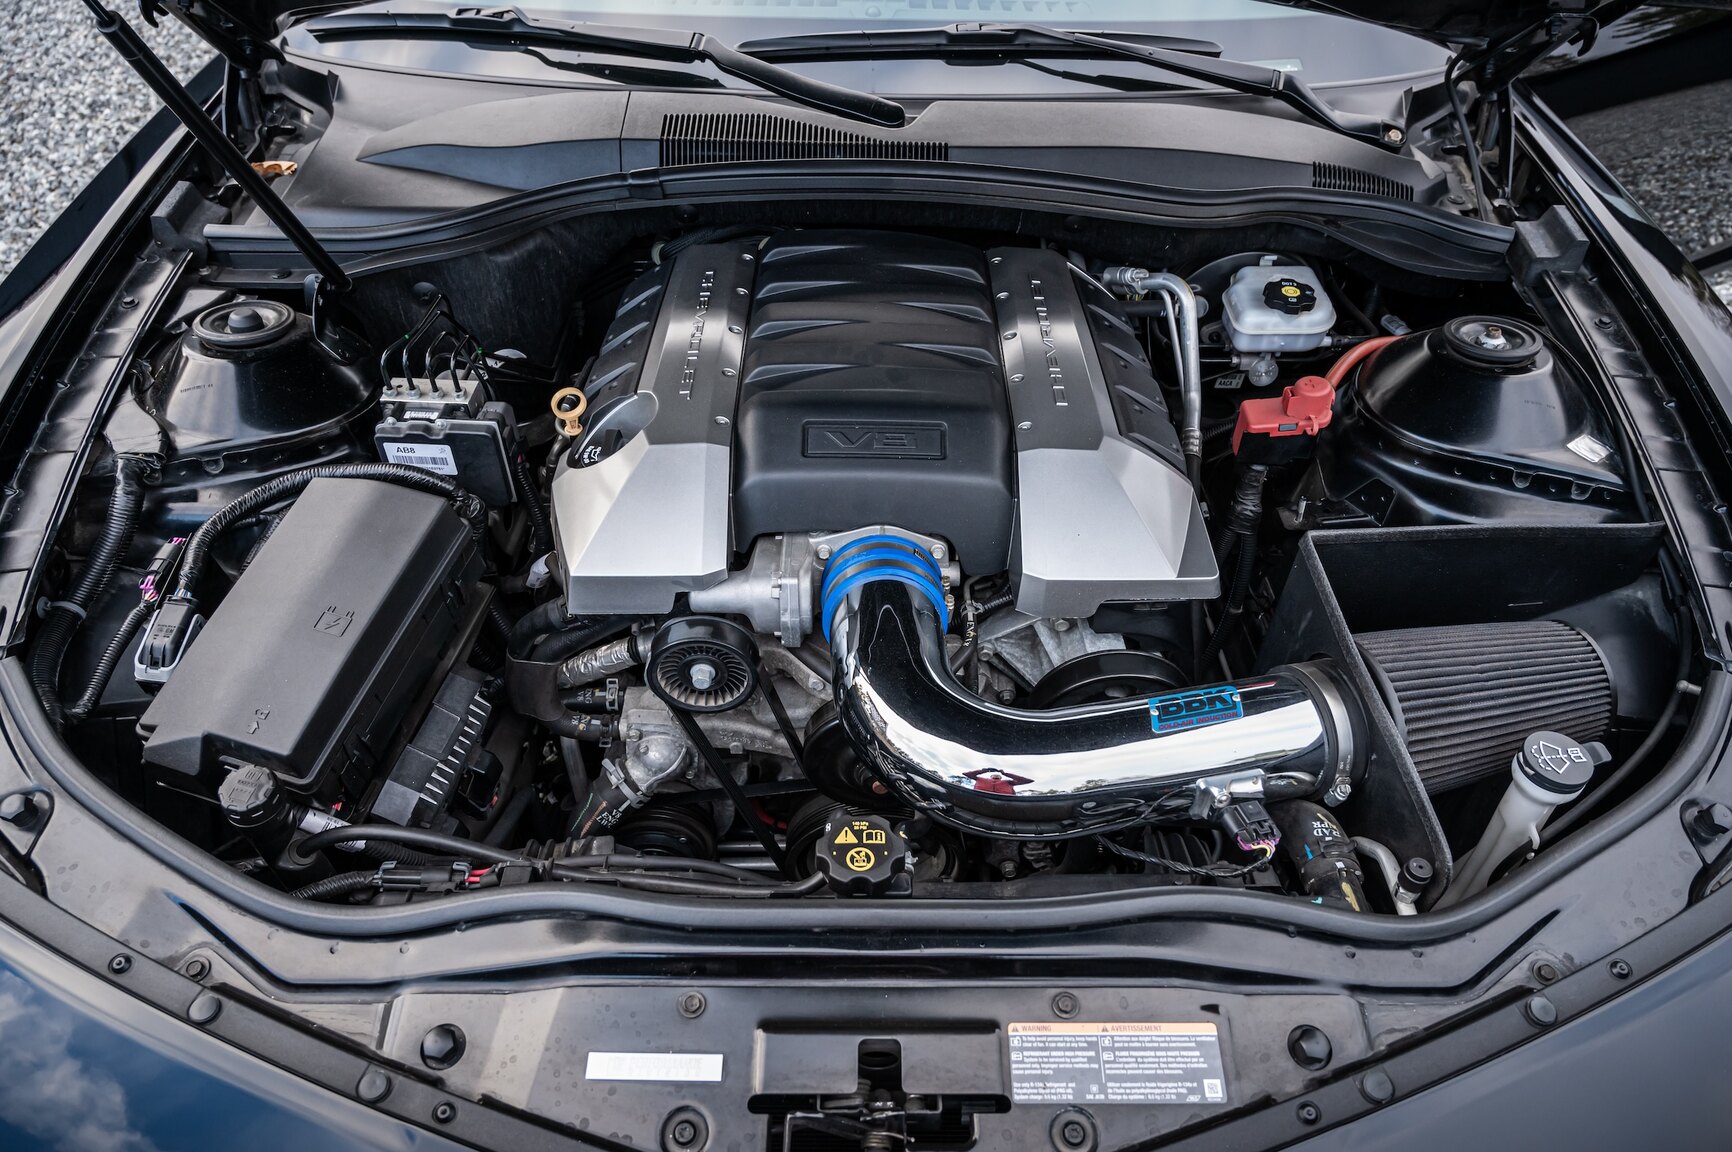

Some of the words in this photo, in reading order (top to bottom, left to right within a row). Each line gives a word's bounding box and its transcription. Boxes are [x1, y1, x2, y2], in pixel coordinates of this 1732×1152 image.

[679, 271, 714, 400] CHEVROLET
[1028, 273, 1068, 406] CHEVROLET
[396, 446, 416, 454] AB8
[1158, 689, 1231, 716] BBK
[1314, 828, 1341, 838] RAD
